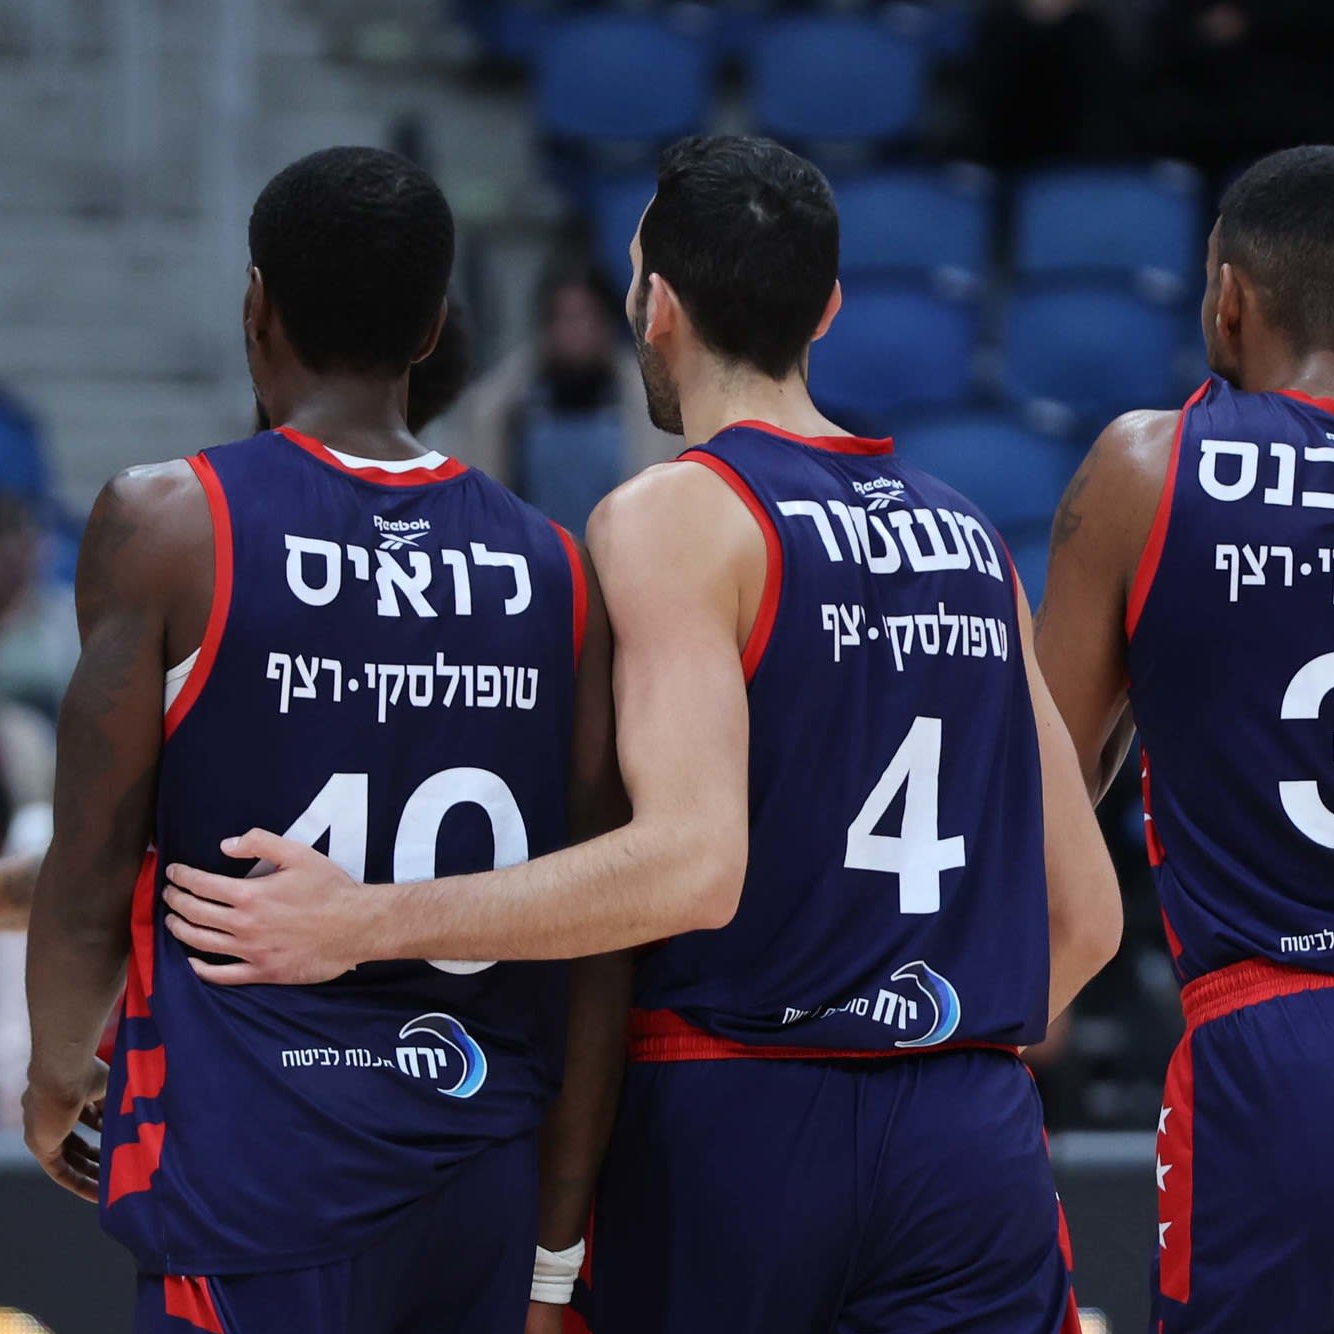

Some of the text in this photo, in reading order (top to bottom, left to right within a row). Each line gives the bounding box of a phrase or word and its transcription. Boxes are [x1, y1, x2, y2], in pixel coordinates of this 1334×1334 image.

[373, 515, 431, 532] Reebok
[284, 534, 532, 618] לואיס
[843, 715, 966, 914] 4
[281, 1047, 340, 1067] לביטוח
